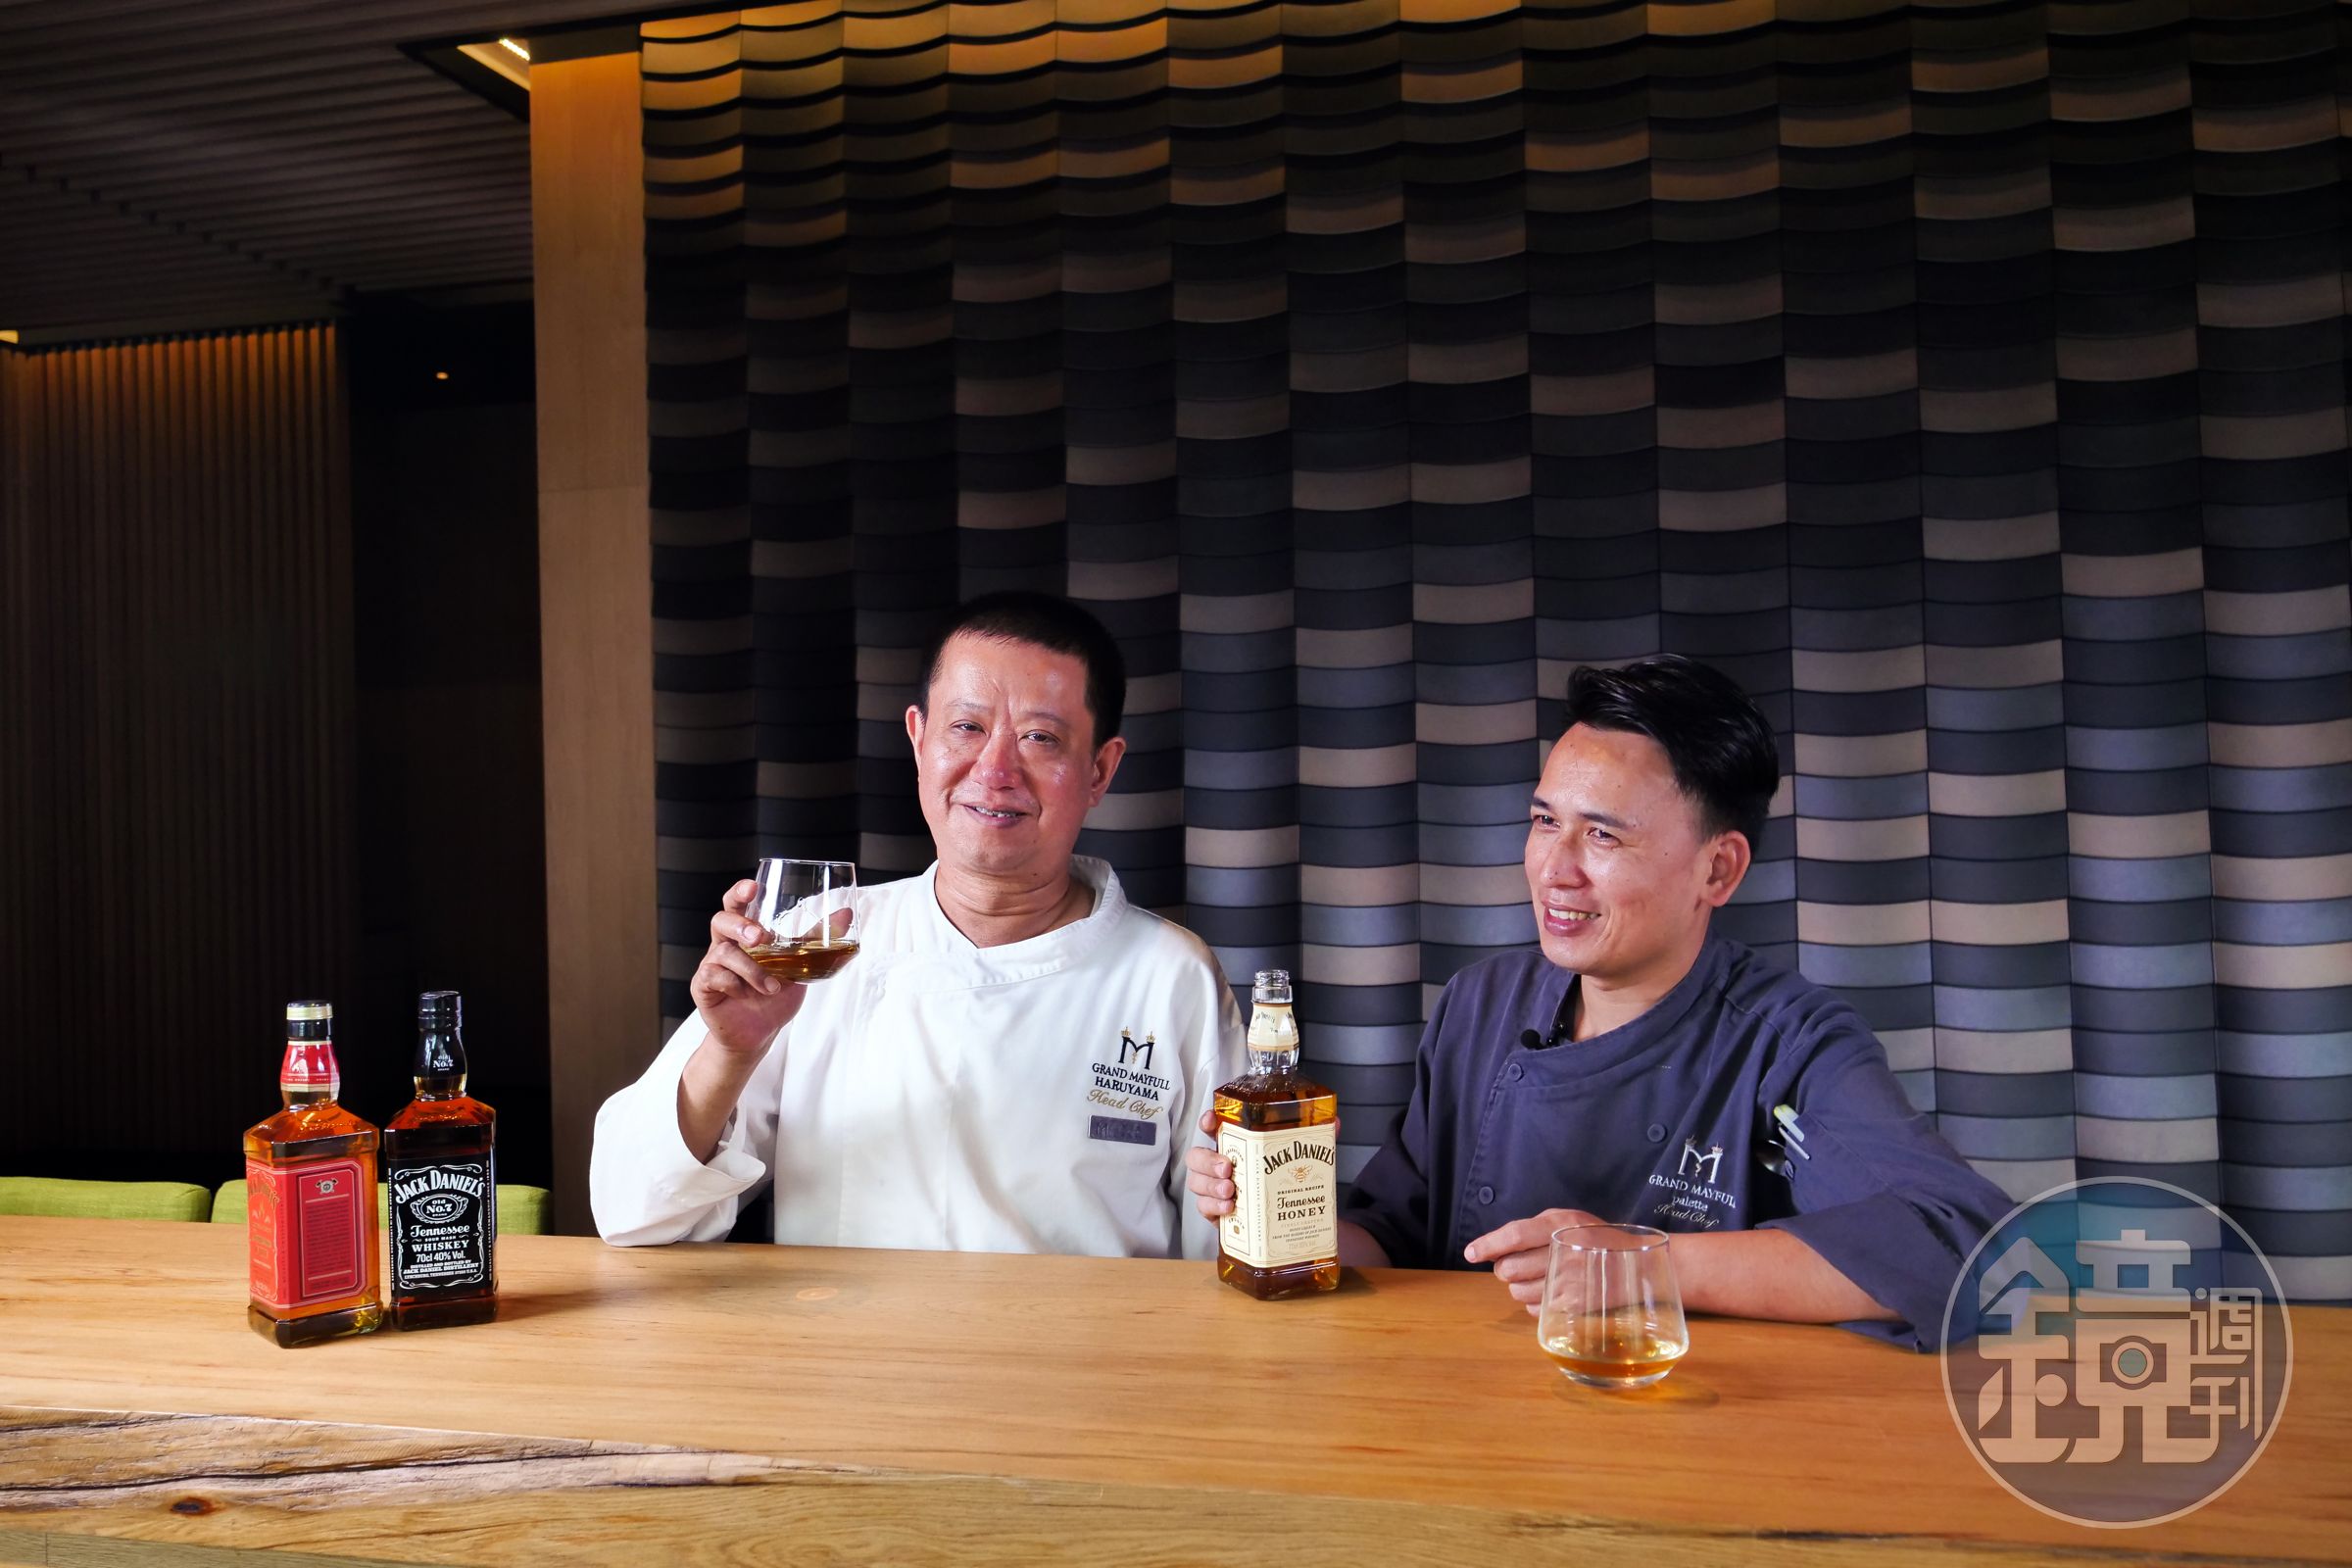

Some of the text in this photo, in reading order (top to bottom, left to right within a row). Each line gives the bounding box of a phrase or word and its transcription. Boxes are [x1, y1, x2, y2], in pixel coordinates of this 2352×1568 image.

[1092, 1062, 1171, 1091] GRAND MAYFULL
[1095, 1076, 1159, 1102] HARUYAMA
[1087, 1089, 1164, 1121] Head Chef
[1262, 1146, 1292, 1175] JACK
[1293, 1140, 1335, 1167] DANIEL'S
[394, 1169, 486, 1204] JACK DANIEL'S
[1648, 1174, 1689, 1192] GRAND
[425, 1203, 453, 1214] No.7
[1277, 1195, 1326, 1209] Tennessee
[1672, 1196, 1709, 1212] palette
[1277, 1206, 1325, 1221] HONEY
[410, 1224, 470, 1238] Tennessee
[412, 1240, 470, 1252] WHISKEY
[416, 1250, 466, 1263] 70cl 40% Vol.
